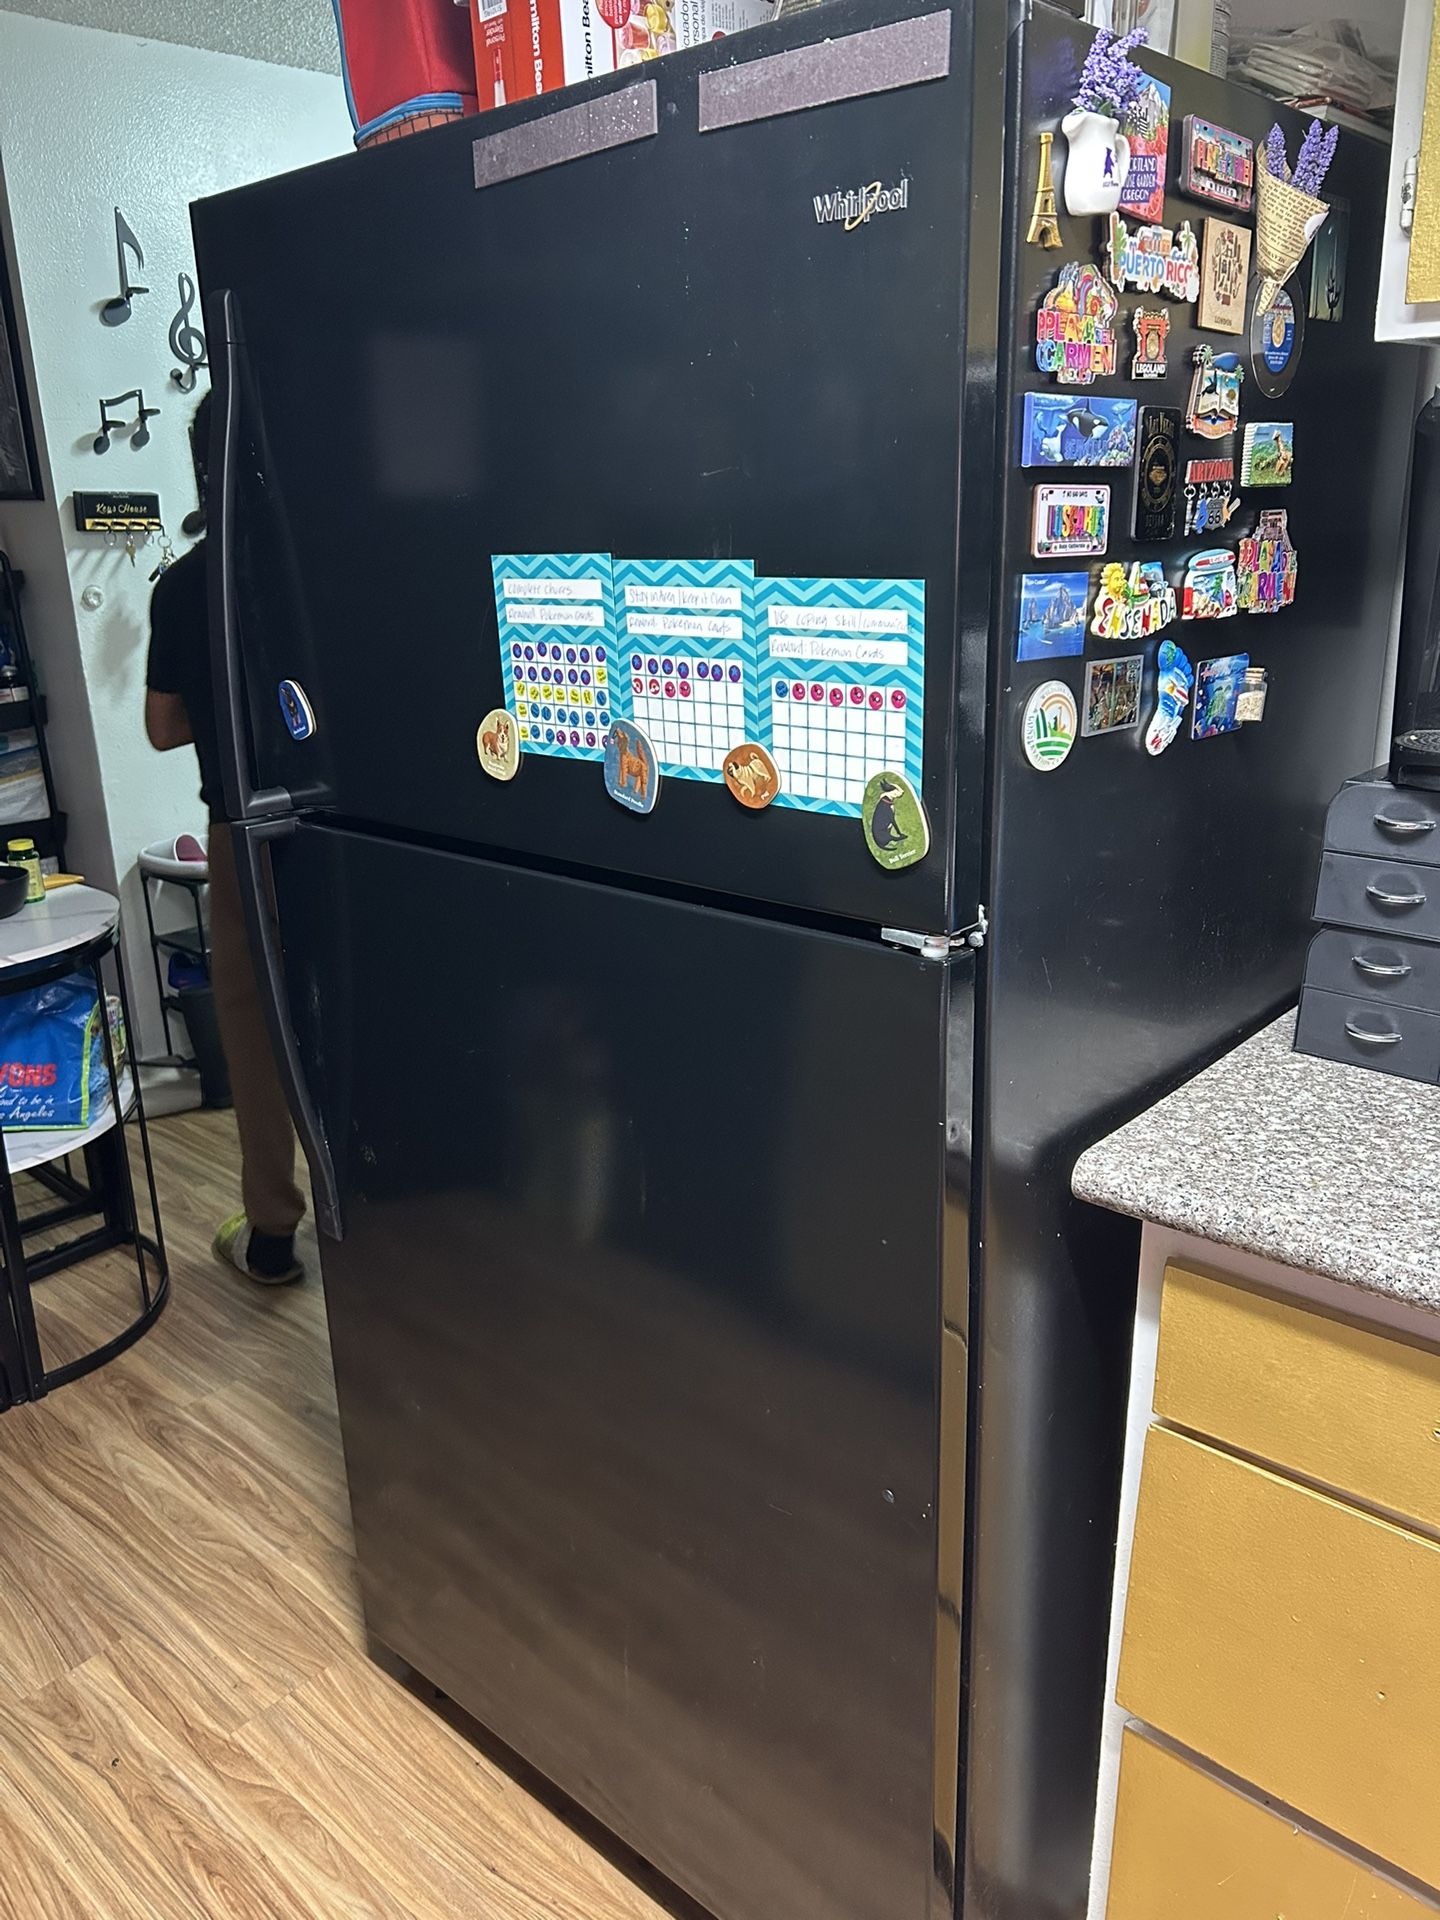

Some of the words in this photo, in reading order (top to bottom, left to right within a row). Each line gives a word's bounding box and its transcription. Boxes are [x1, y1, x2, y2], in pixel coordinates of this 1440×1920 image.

[813, 178, 908, 224] Whirlpool
[1118, 249, 1165, 280] PUERTO
[1135, 362, 1167, 375] LEGOLAND
[1190, 461, 1234, 482] ARIZONA
[1208, 510, 1221, 525] 66
[1097, 589, 1179, 639] ENSENADA
[9, 1104, 56, 1122] Angeles
